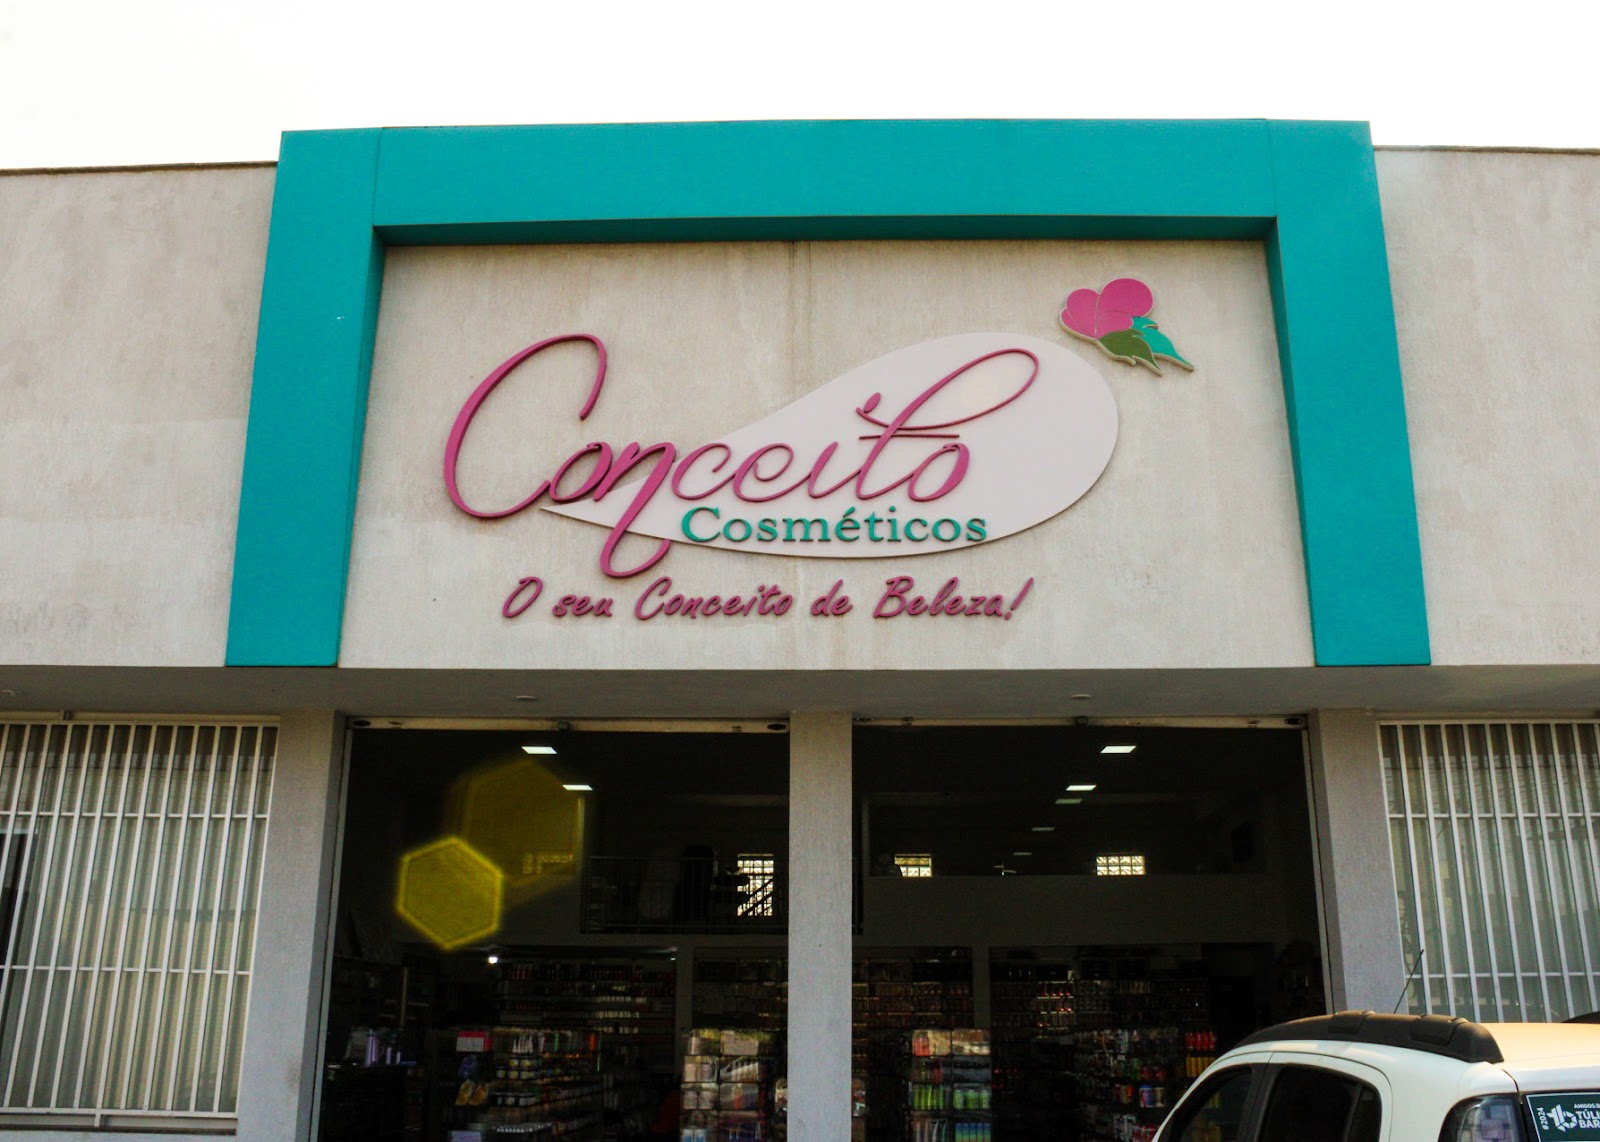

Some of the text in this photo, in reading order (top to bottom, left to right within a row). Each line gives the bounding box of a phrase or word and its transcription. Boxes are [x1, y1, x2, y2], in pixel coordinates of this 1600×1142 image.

[442, 333, 1039, 578] Conceito
[681, 506, 987, 543] Cosméticos
[502, 575, 1034, 620] O seu Conceito de Beleza!
